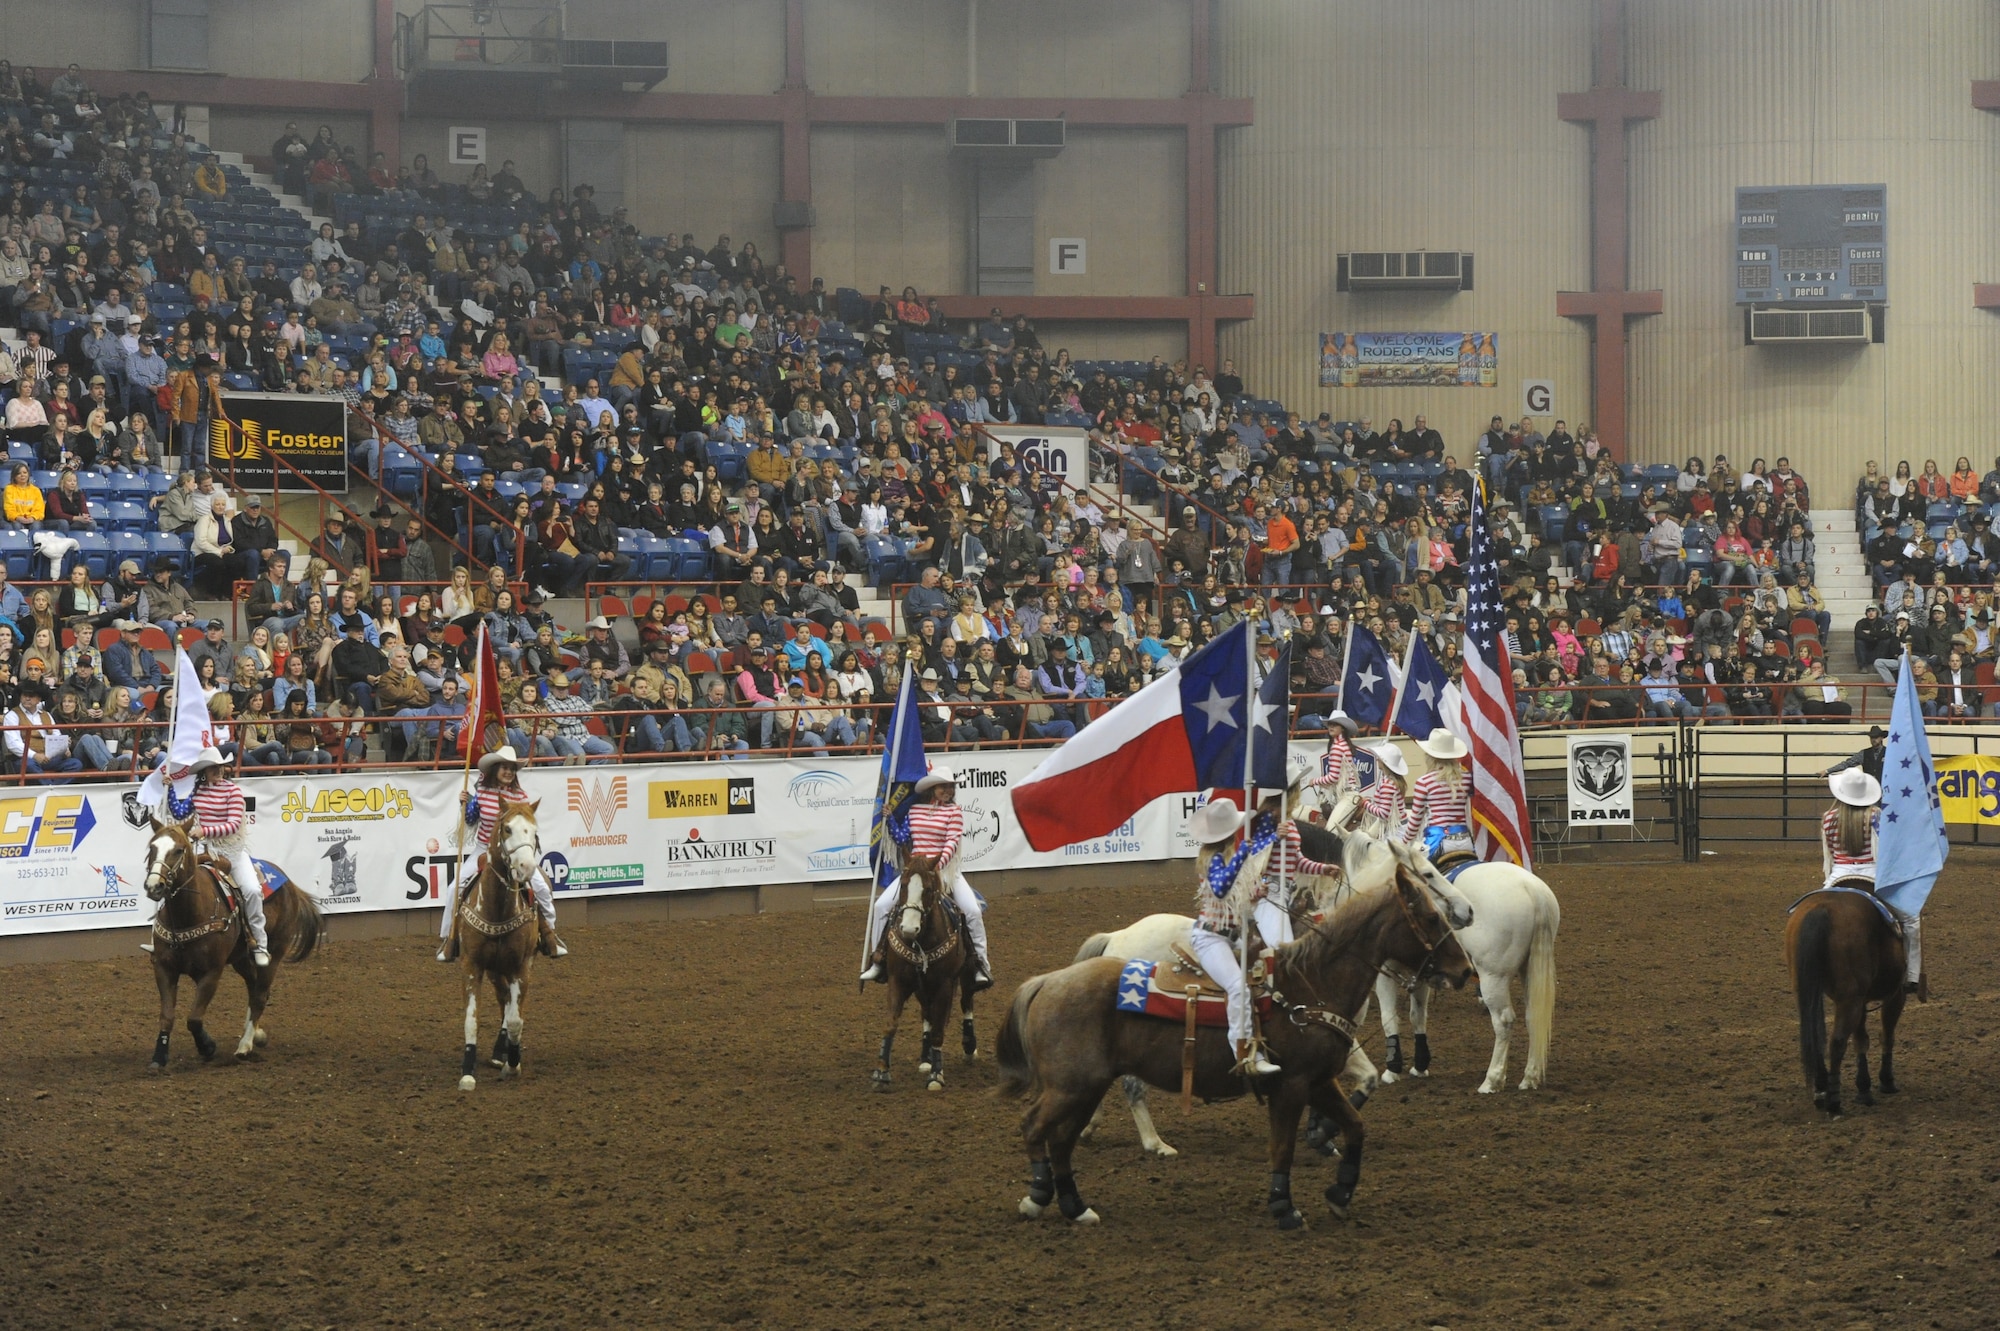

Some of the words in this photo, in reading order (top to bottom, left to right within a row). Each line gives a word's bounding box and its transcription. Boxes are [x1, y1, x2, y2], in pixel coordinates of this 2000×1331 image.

[456, 133, 478, 160] E
[1741, 213, 1775, 224] penalty
[1845, 211, 1880, 223] penalty
[1058, 244, 1079, 270] F
[1742, 250, 1767, 261] Home
[1850, 249, 1881, 259] Guests
[1786, 273, 1792, 281] 1
[1800, 273, 1806, 281] 2
[1816, 272, 1822, 281] 3
[1829, 272, 1836, 281] 4
[1795, 286, 1824, 298] period
[1373, 335, 1445, 346] WELCOME
[1362, 347, 1412, 357] RODEO
[1417, 346, 1455, 357] FANS
[1527, 385, 1550, 412] G
[267, 429, 344, 448] Foster
[1830, 546, 1836, 554] 3
[1835, 566, 1840, 574] 2
[663, 790, 718, 809] WARREN
[730, 786, 754, 806] CAT
[1934, 768, 2000, 818] rang
[1571, 809, 1631, 820] RAM
[43, 819, 75, 827] Equipment
[570, 834, 628, 848] WHATABURGER
[1065, 842, 1090, 856] Inns
[1092, 844, 1101, 854] &
[1104, 839, 1141, 853] Suites
[807, 853, 846, 869] Nichols
[848, 851, 865, 867] Oil
[17, 866, 69, 880] 325-653-2121
[570, 868, 596, 882] Angelo
[598, 866, 626, 879] Pellets,
[628, 865, 643, 877] Inc.
[5, 902, 74, 915] WESTERN
[79, 898, 137, 911] TOWERS
[320, 896, 361, 905] FOUNDATION
